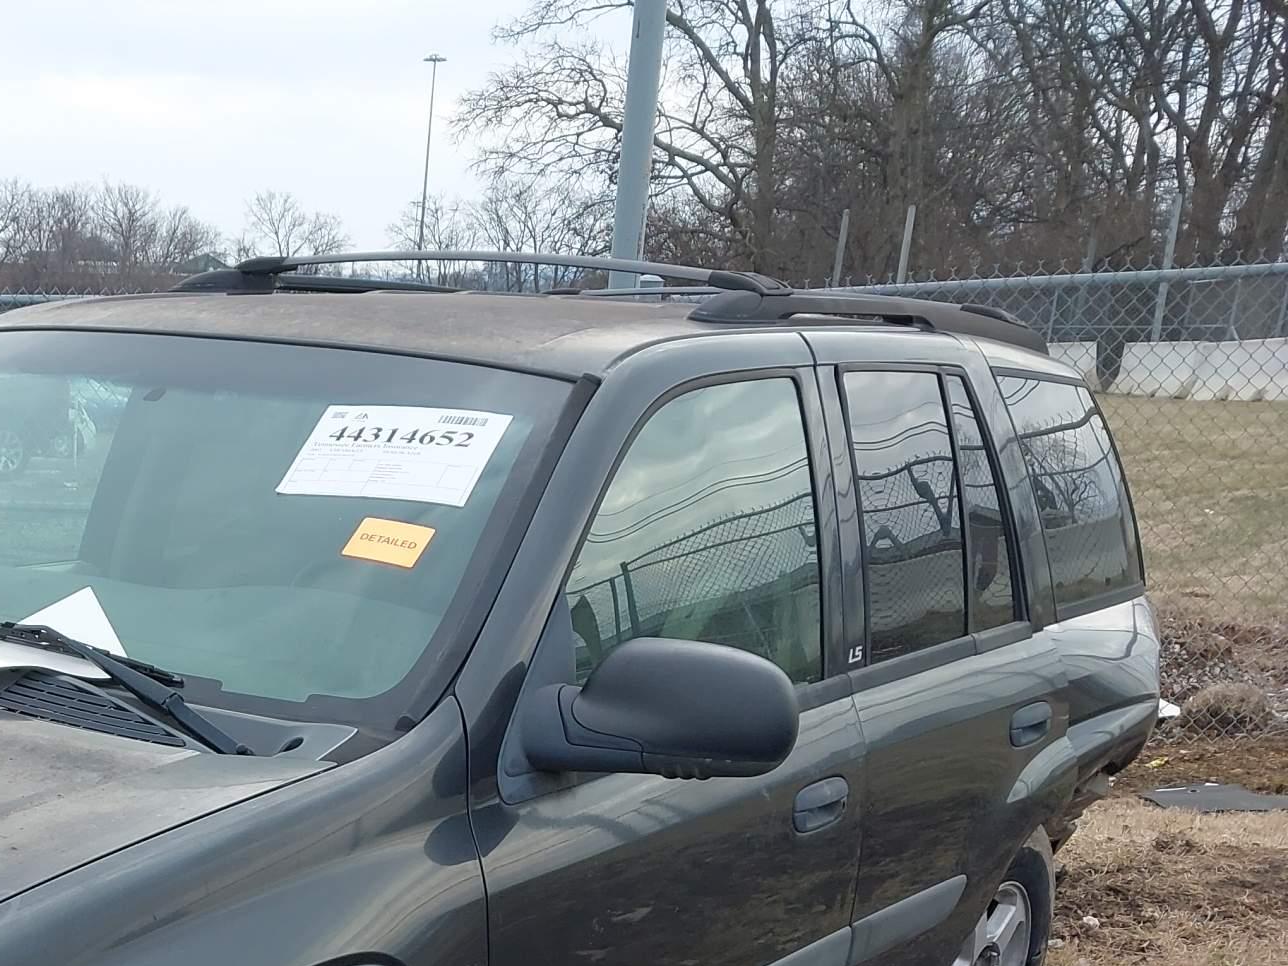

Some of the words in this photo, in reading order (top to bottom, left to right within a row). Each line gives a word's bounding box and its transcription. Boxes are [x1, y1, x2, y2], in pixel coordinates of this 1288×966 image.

[328, 425, 475, 449] 44314652
[359, 532, 418, 550] DETAILED
[847, 645, 863, 664] LS
